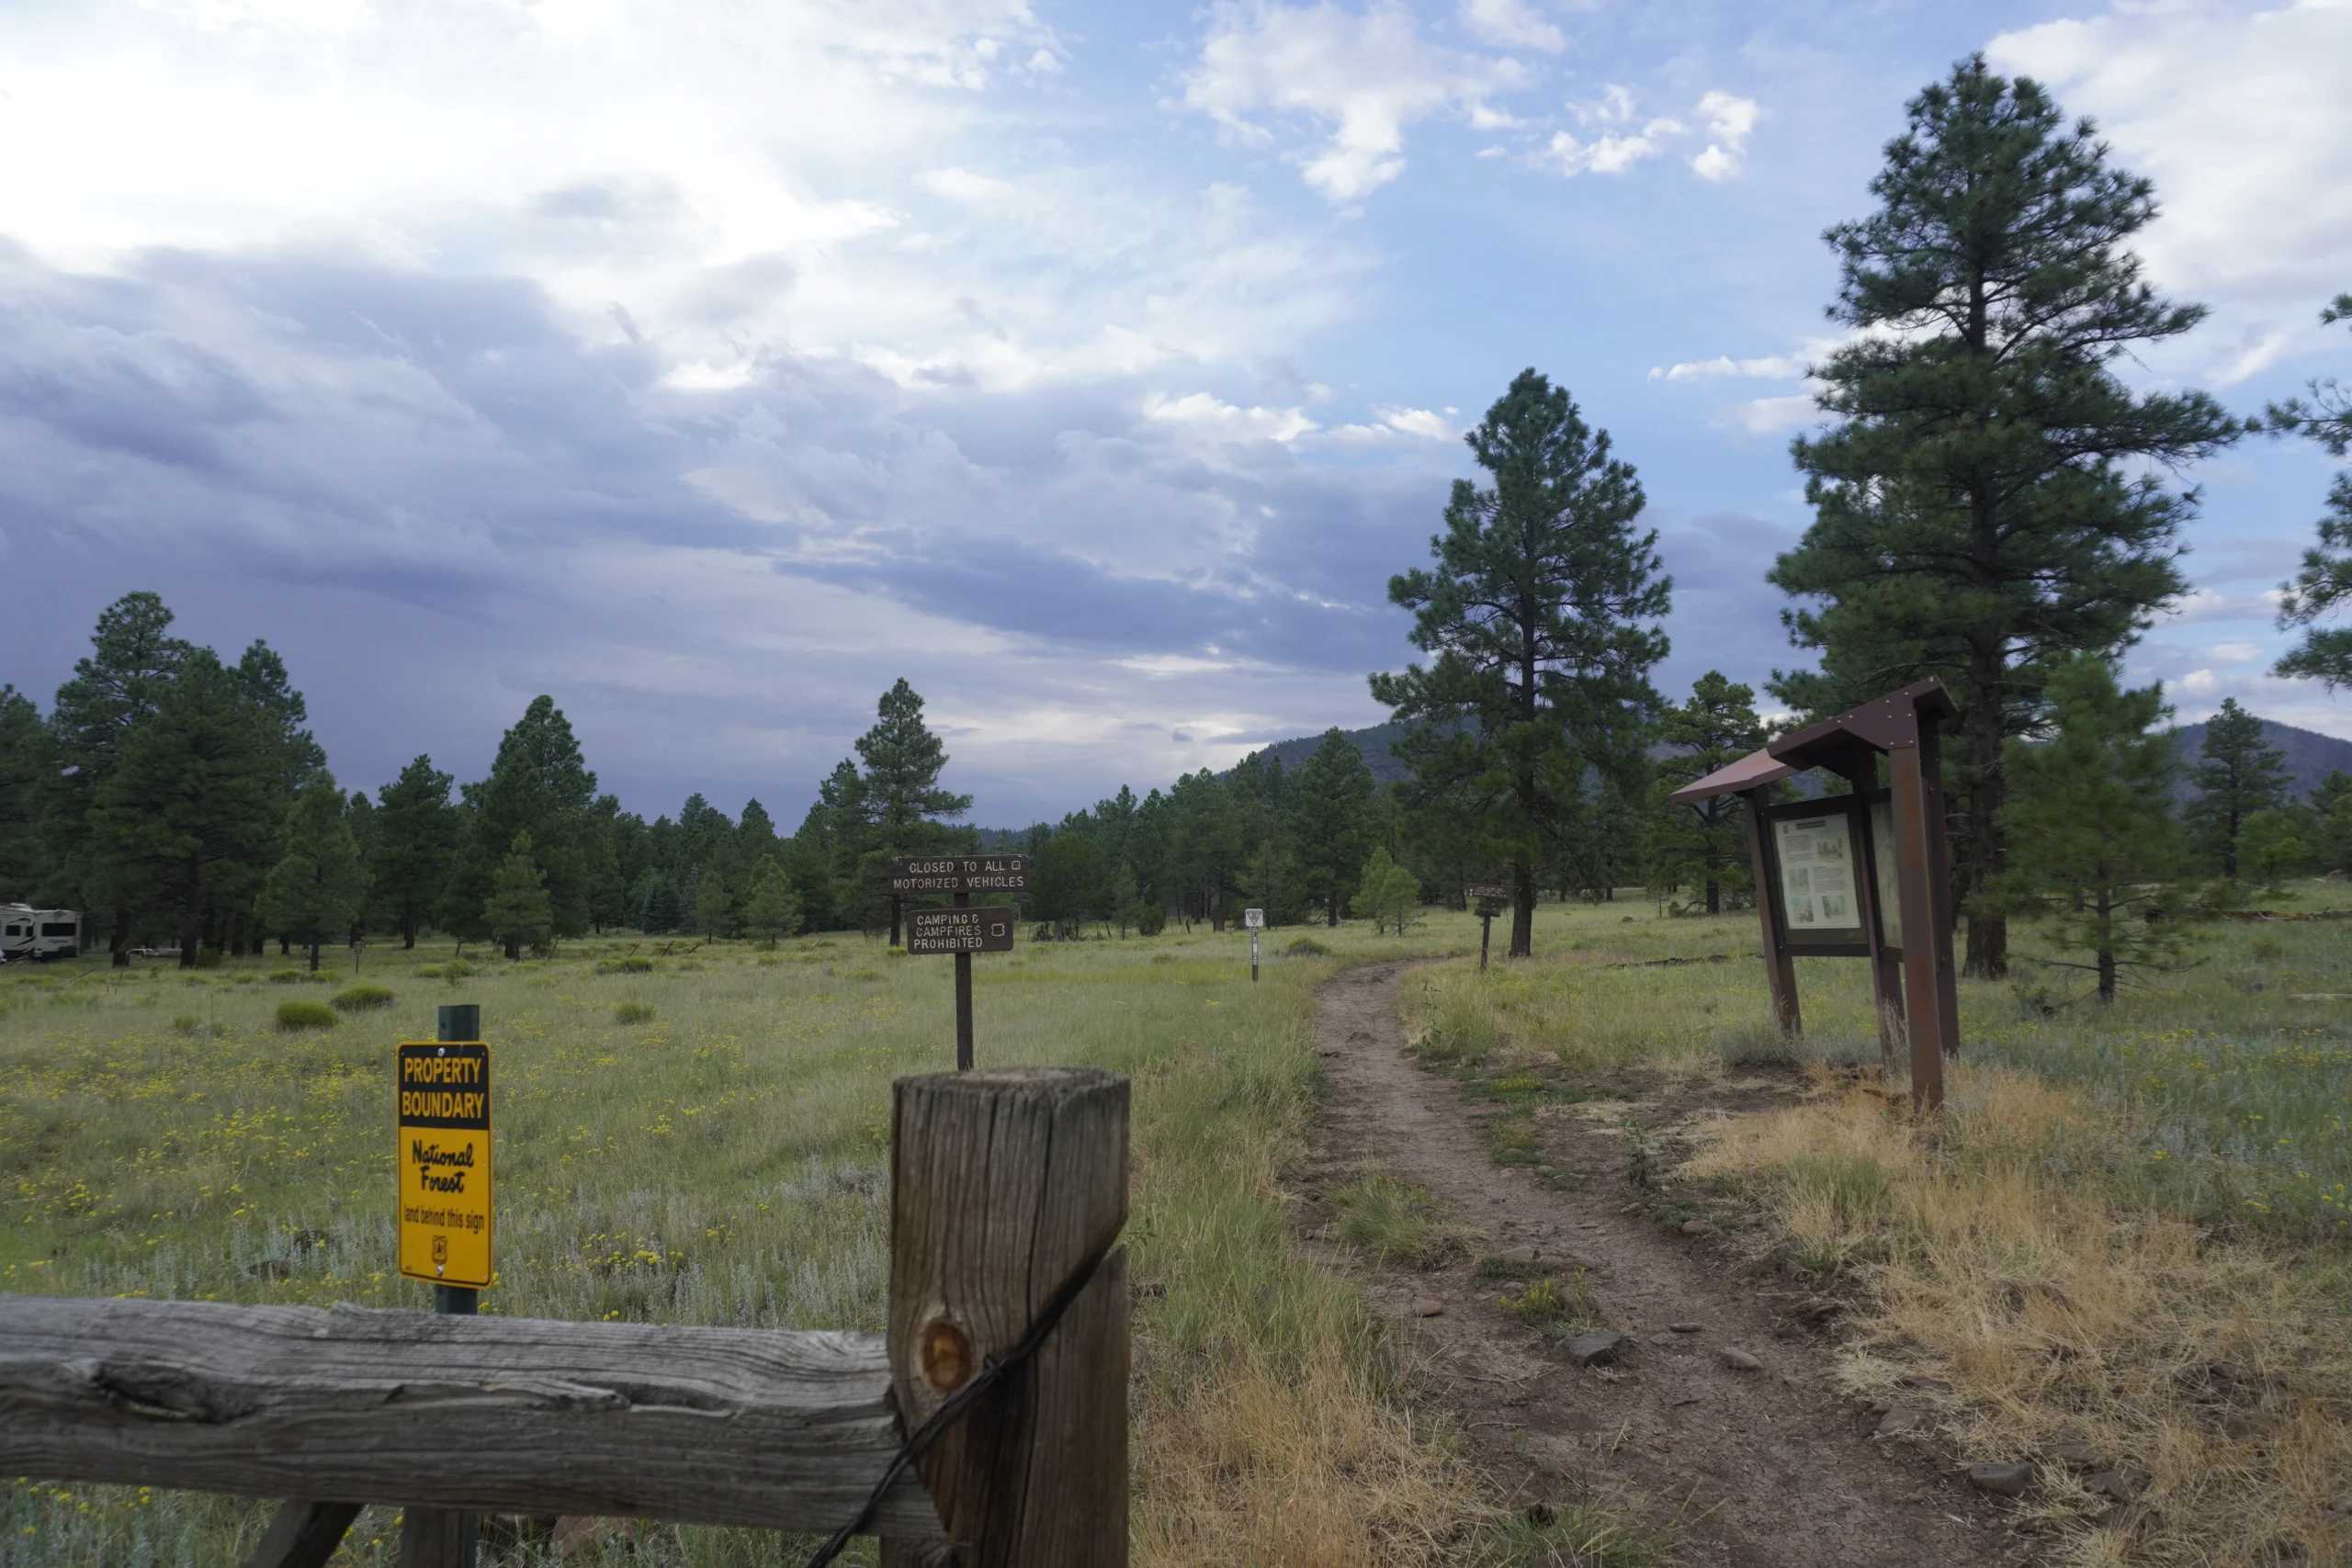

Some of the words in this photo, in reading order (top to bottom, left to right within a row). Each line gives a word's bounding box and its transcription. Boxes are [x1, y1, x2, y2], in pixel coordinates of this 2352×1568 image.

[909, 862, 954, 873] CLOSED
[963, 862, 977, 872] TO
[985, 861, 1005, 871] ALL
[894, 878, 958, 889] MOTORIZED
[967, 876, 1023, 887] VEHICLES
[917, 915, 967, 925] CAMPING
[973, 914, 978, 923] &
[916, 926, 981, 937] CAMPFIRES
[914, 938, 982, 949] PROHIBITED
[404, 1057, 481, 1083] PROPERTY
[402, 1091, 484, 1118] BOUNDARY
[413, 1140, 474, 1168] National
[420, 1166, 466, 1193] Forest
[404, 1203, 418, 1223] land
[421, 1205, 445, 1226] behind
[447, 1208, 462, 1228] this
[466, 1209, 483, 1235] sign
